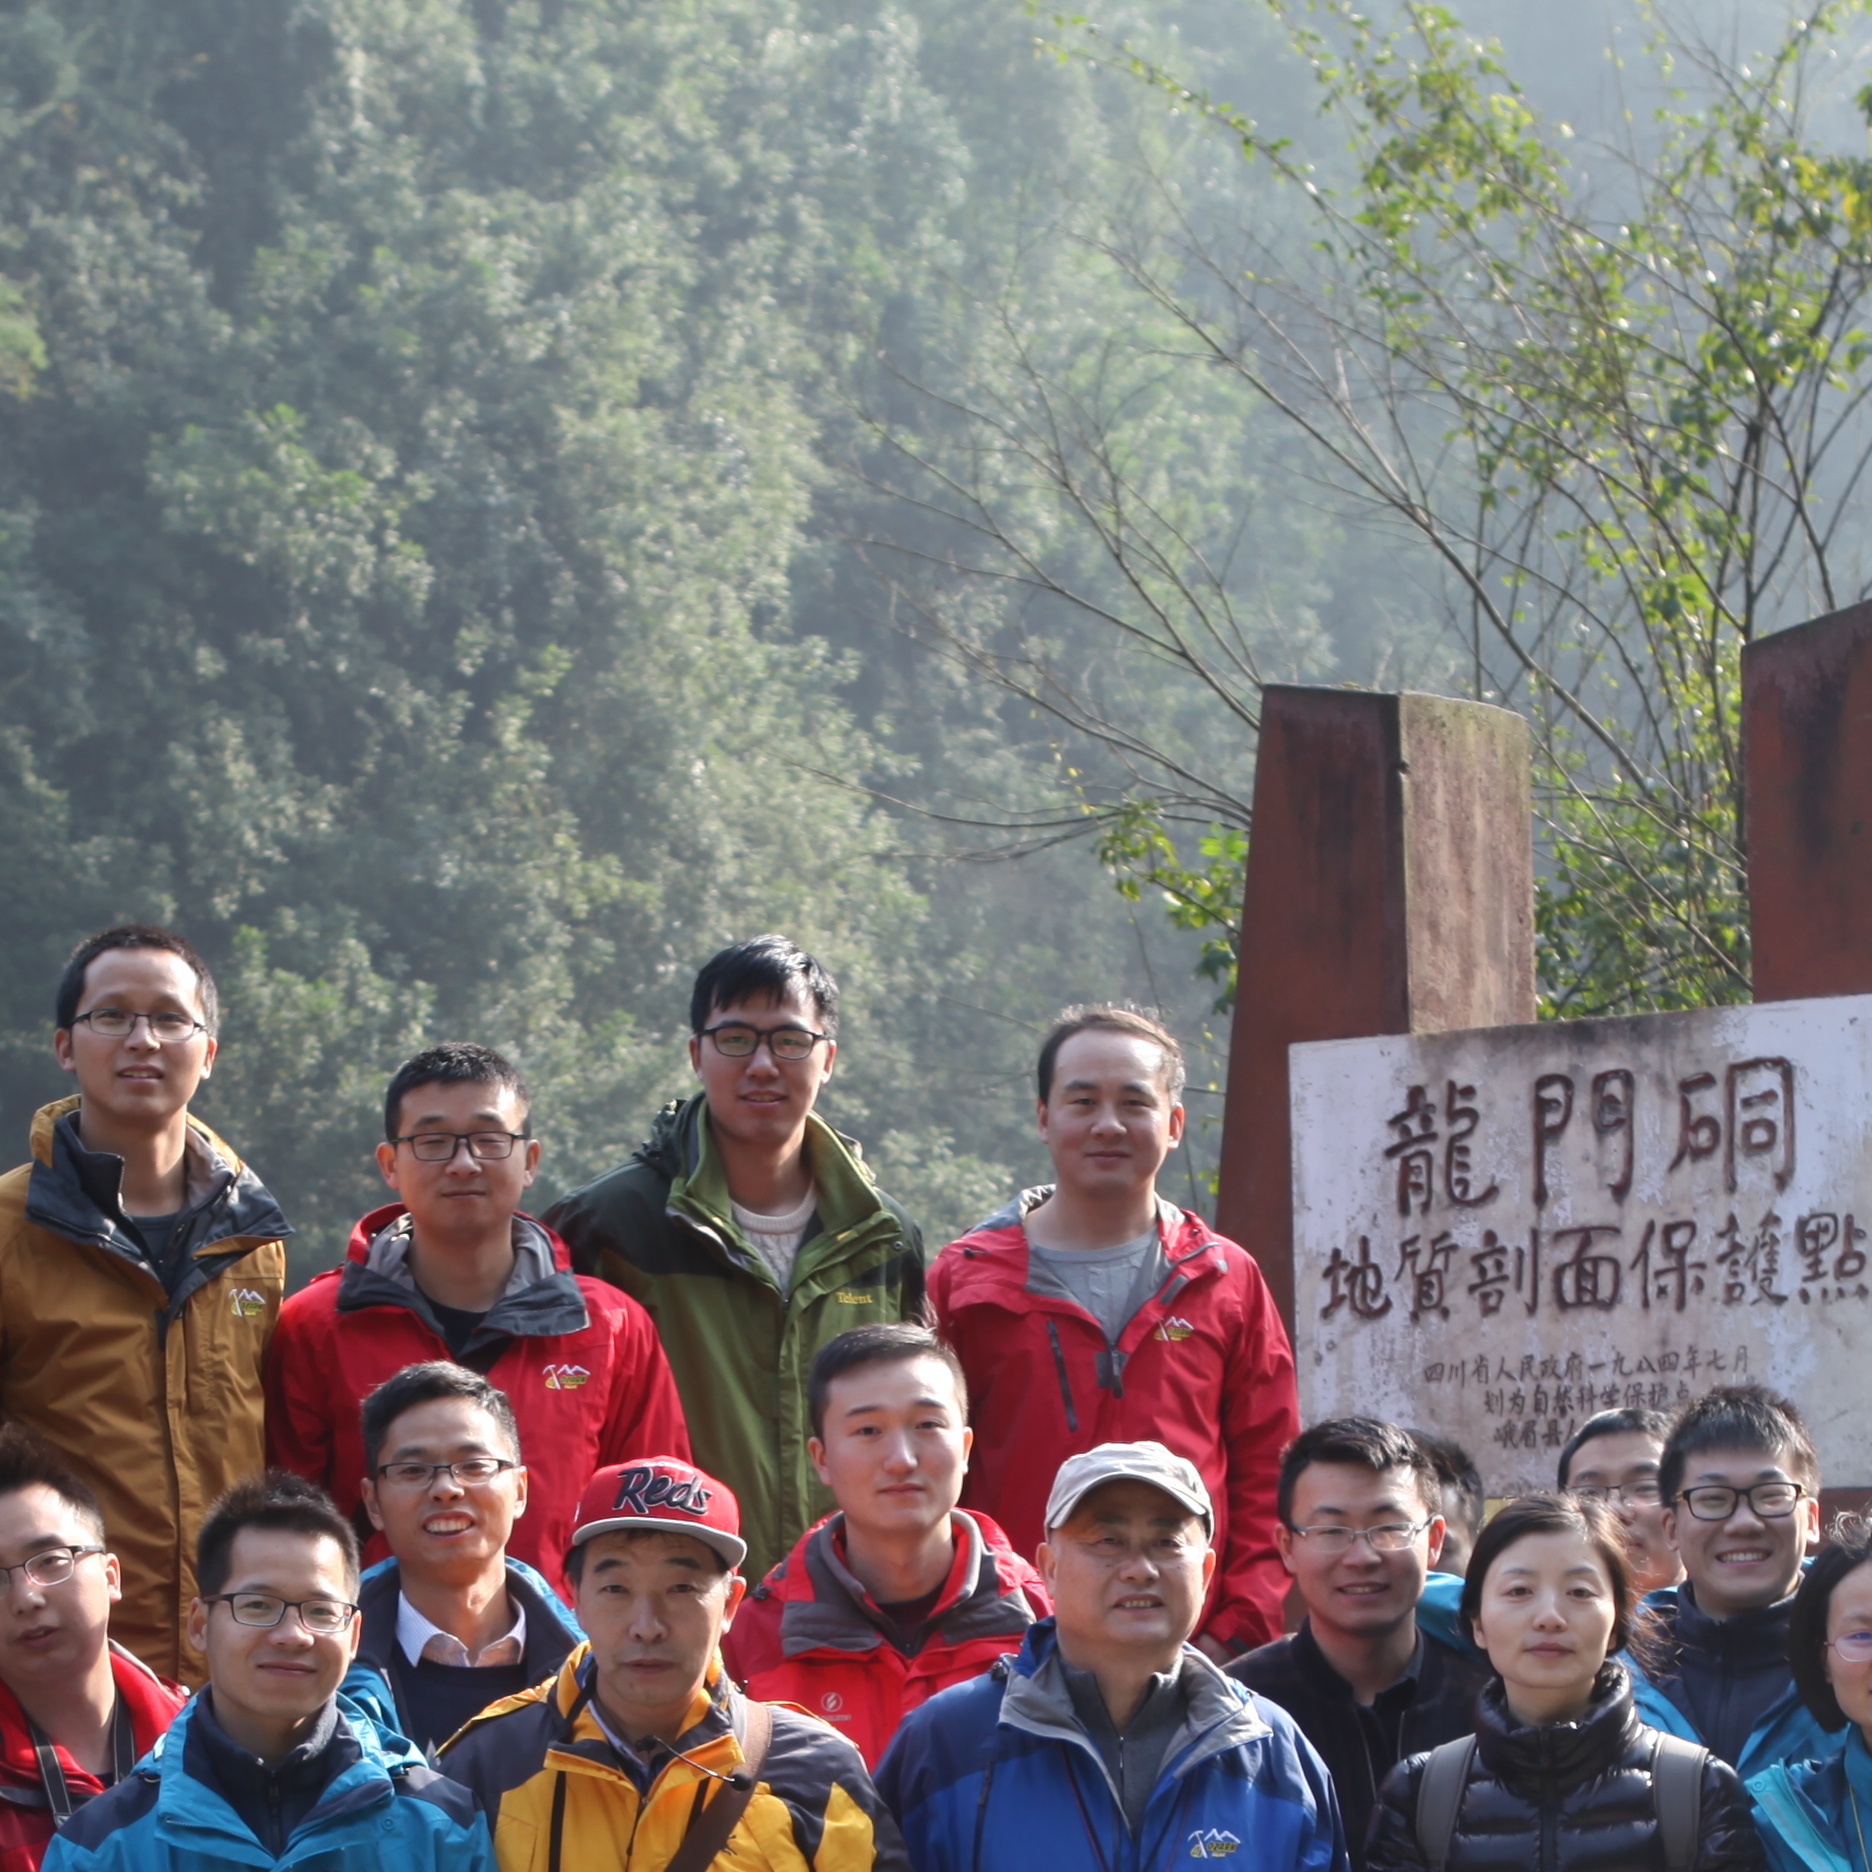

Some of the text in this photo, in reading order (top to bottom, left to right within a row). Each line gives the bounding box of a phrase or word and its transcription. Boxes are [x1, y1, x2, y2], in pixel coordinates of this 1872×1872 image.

[1383, 1055, 1796, 1217] 龍門硐
[1321, 1212, 1870, 1322] 地質剖面保護點
[612, 1466, 713, 1516] Reds
